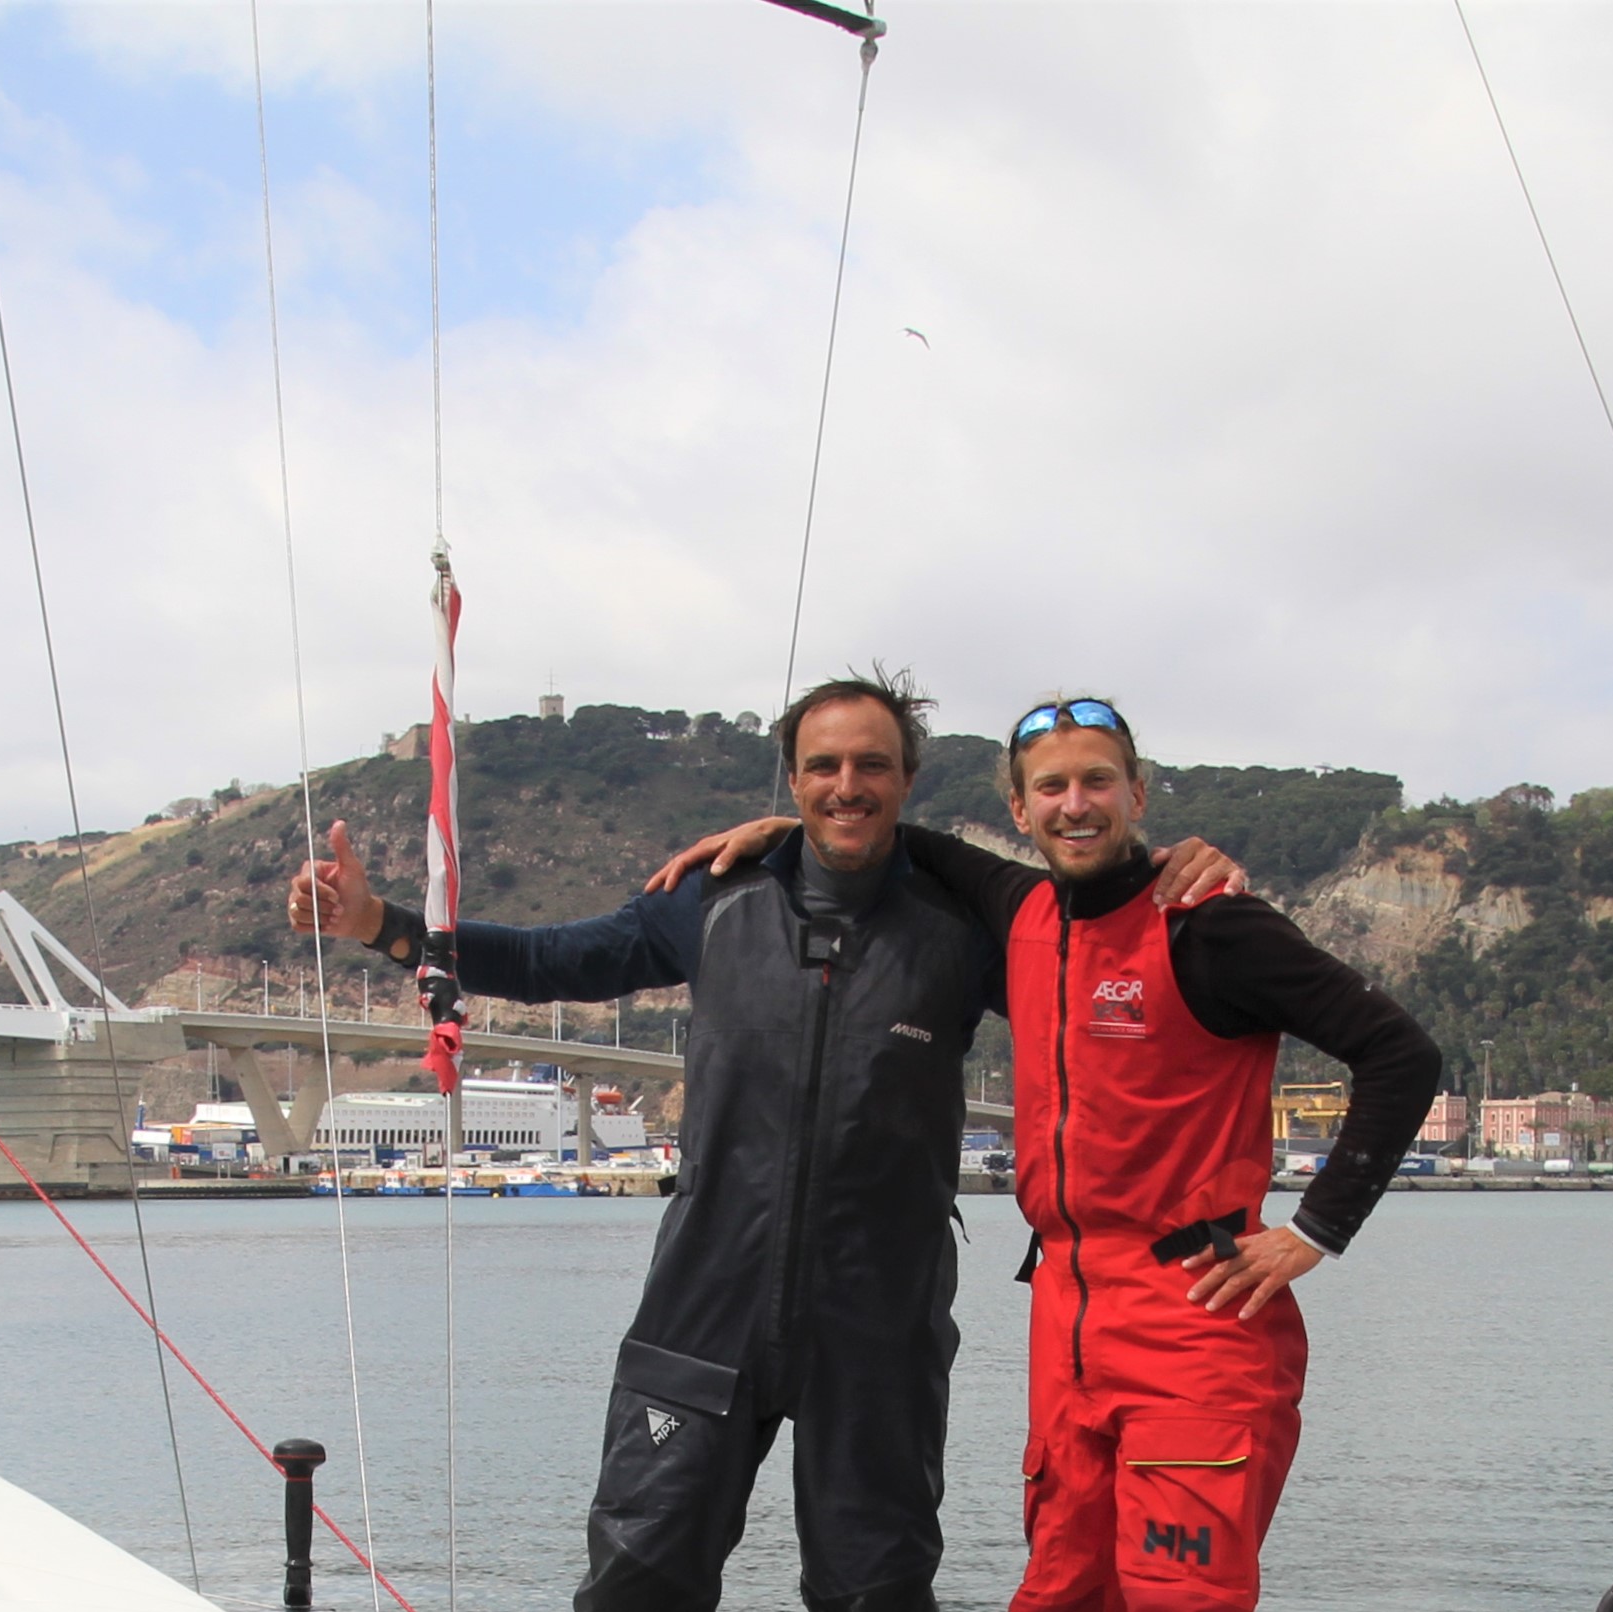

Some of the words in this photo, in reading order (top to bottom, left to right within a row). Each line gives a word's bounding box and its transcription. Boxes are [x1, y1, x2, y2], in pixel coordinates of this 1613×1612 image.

[890, 1022, 932, 1043] MUSTO
[652, 1415, 681, 1446] MPX
[1144, 1519, 1211, 1566] HH
